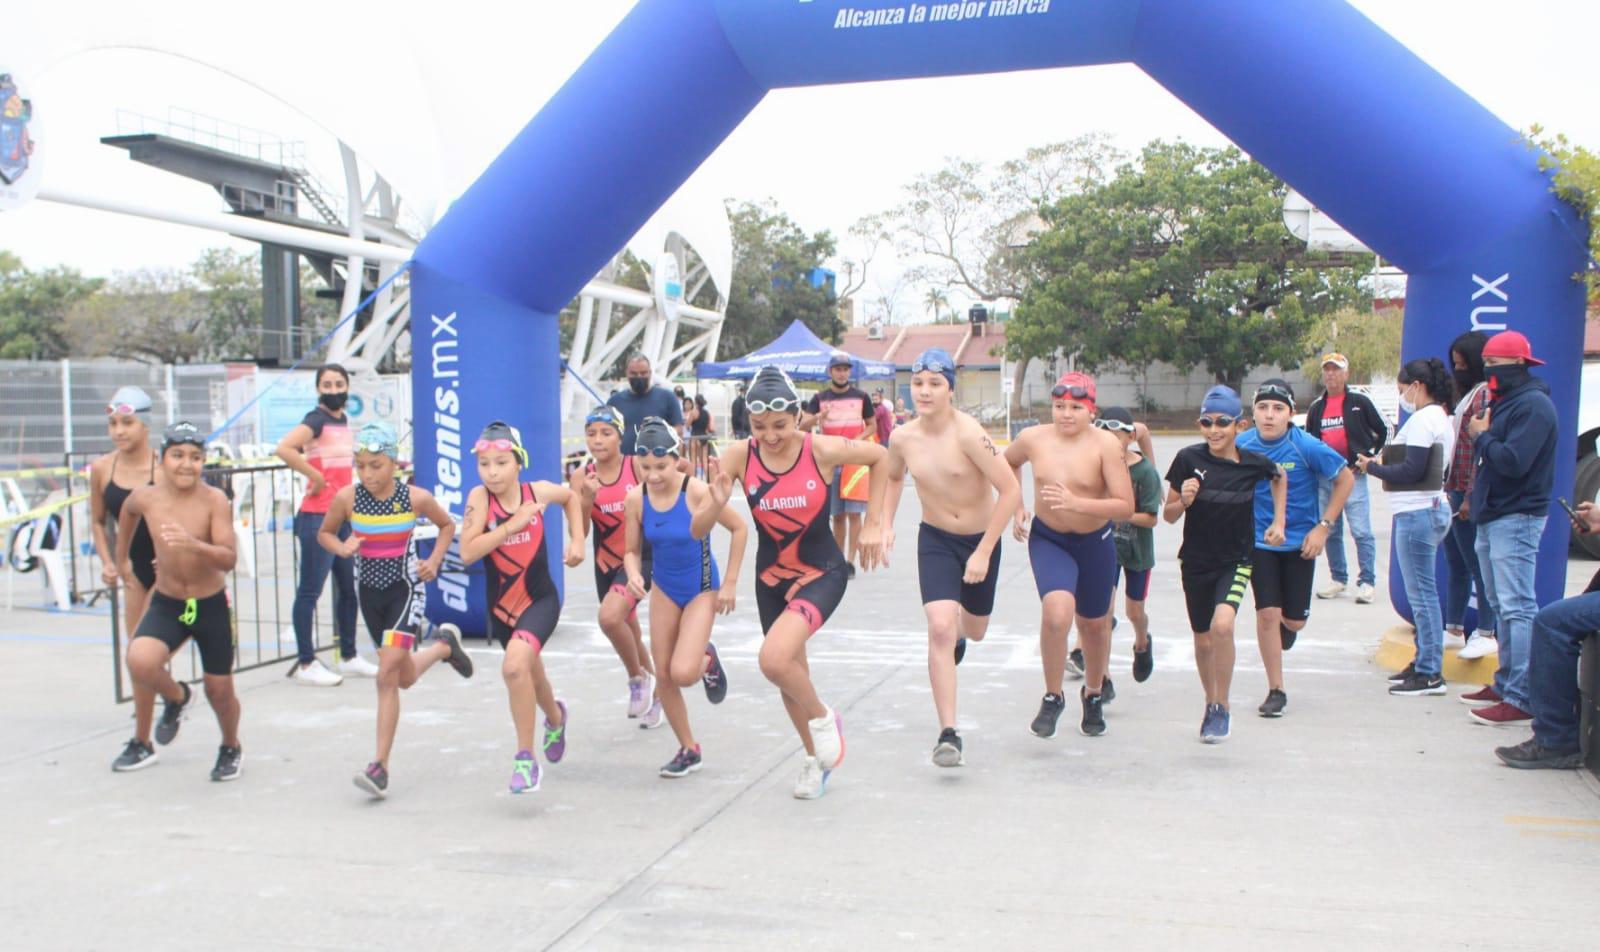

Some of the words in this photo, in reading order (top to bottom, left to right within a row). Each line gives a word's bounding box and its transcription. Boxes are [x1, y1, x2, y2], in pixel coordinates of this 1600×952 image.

[834, 8, 905, 29] Alcanza
[908, 4, 927, 24] la
[929, 1, 986, 22] mejor
[988, 0, 1050, 17] marca
[759, 495, 807, 511] ALARDIN
